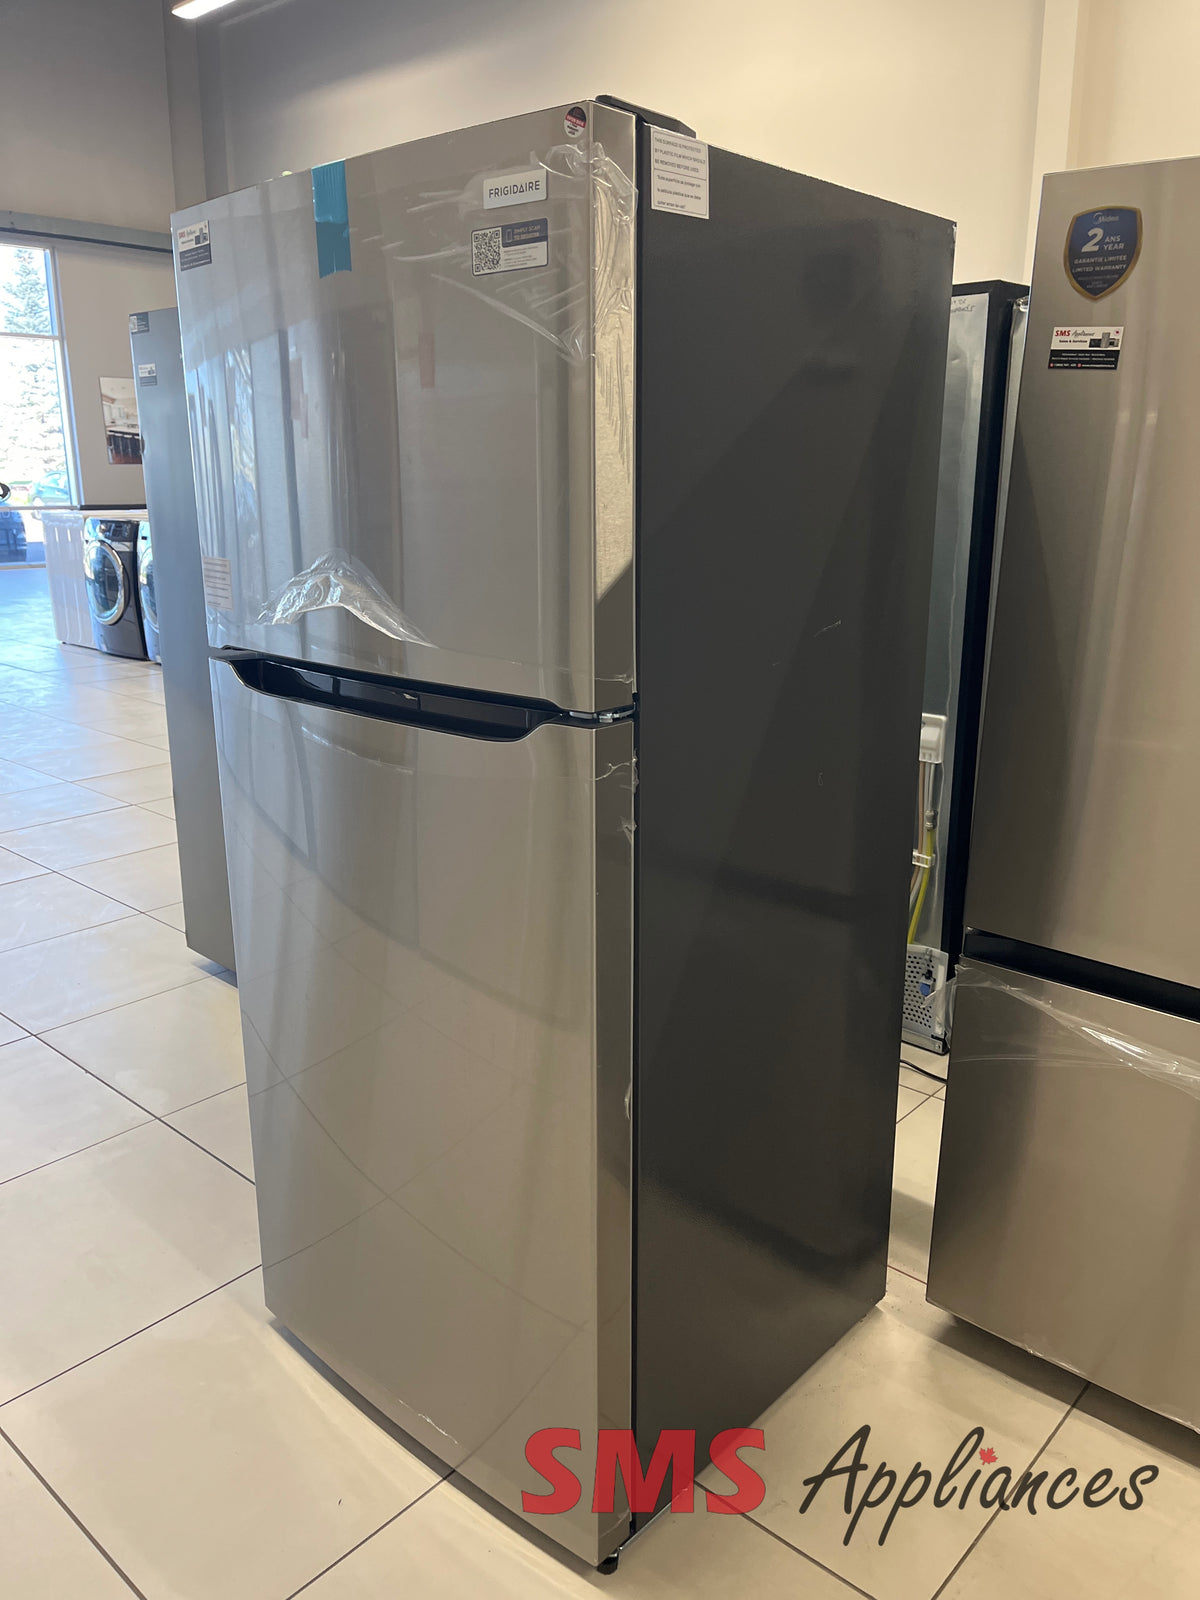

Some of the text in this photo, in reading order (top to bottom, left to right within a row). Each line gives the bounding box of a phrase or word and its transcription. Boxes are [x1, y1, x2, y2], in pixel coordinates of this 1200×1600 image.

[488, 180, 541, 199] FRIGIDAIRE
[1081, 227, 1121, 253] 2 ANS
[1103, 243, 1125, 251] YEAR
[1054, 329, 1071, 337] SMS
